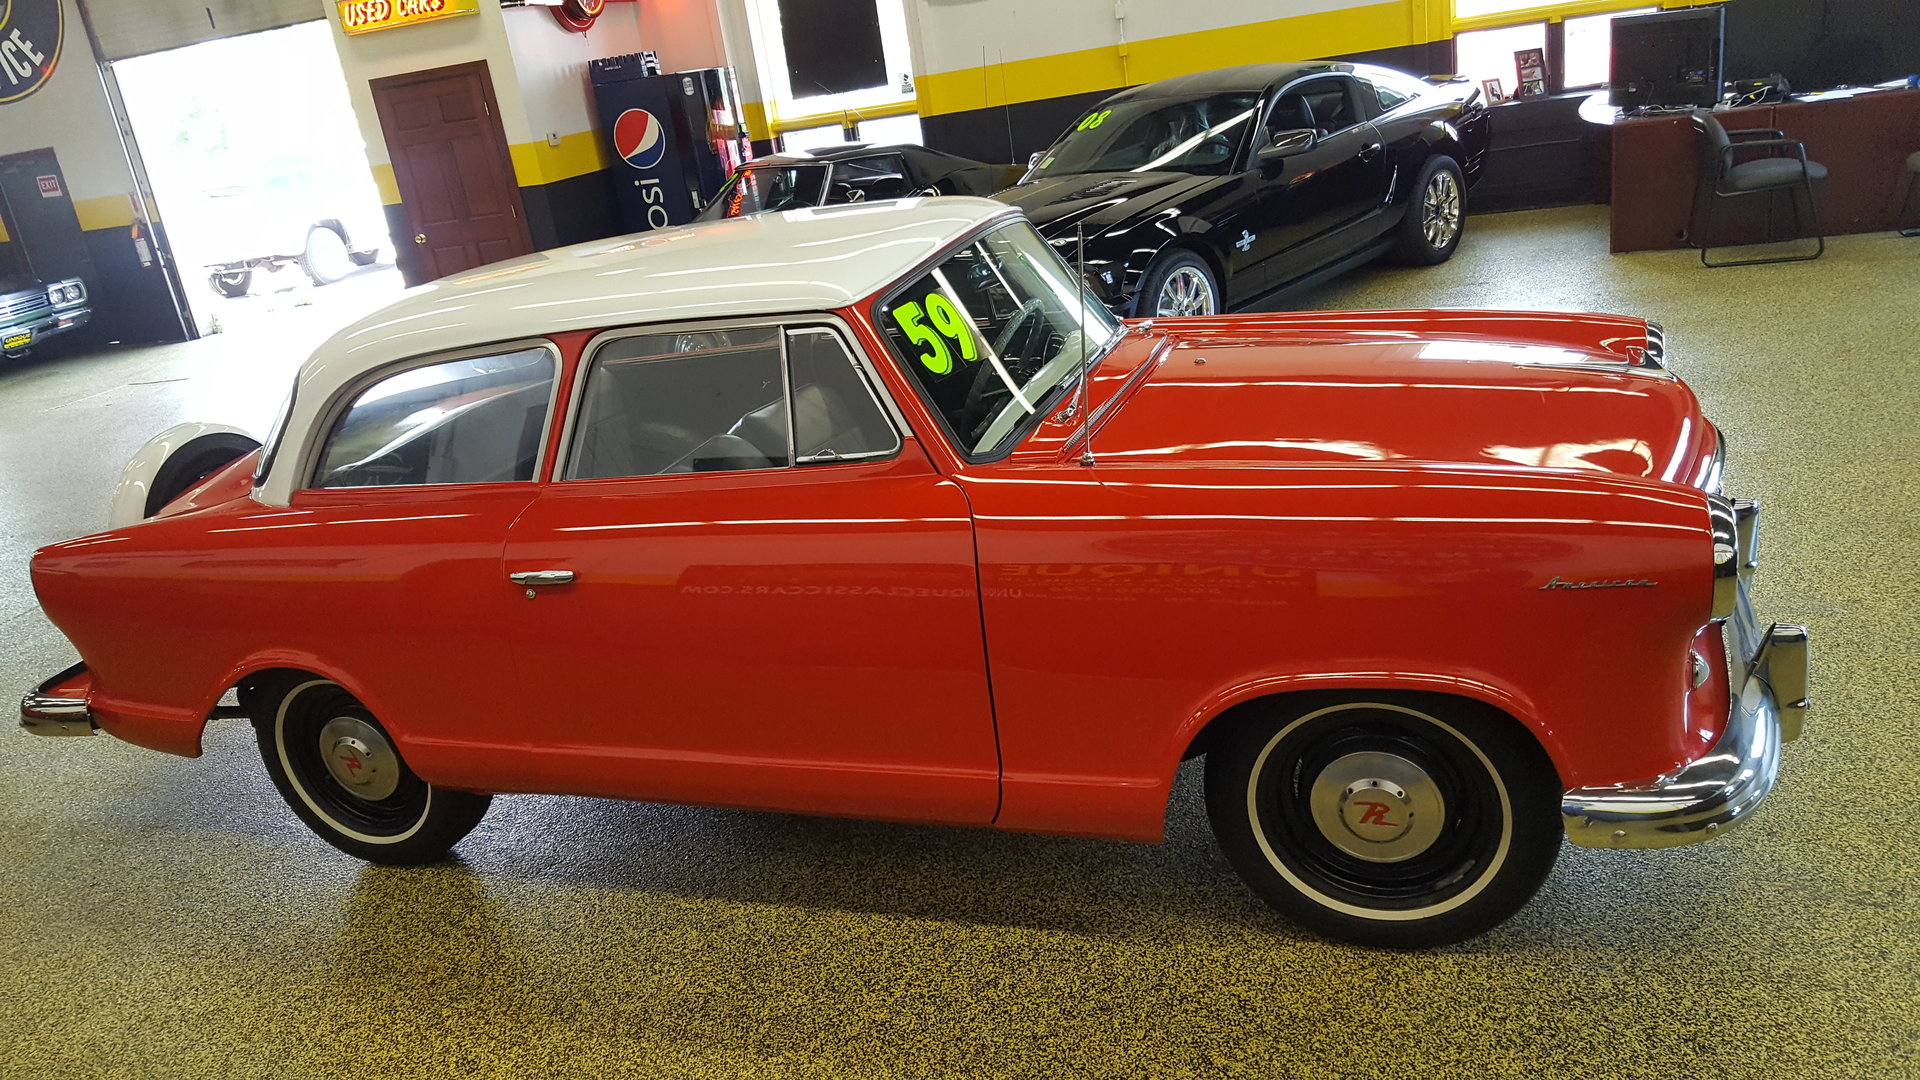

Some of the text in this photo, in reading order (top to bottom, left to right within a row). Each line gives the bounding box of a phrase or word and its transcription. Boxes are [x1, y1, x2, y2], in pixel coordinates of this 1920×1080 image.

[344, 0, 391, 26] USED
[1077, 110, 1112, 131] 08
[40, 179, 58, 190] EXIT
[892, 293, 977, 375] 59
[1538, 576, 1658, 590] American
